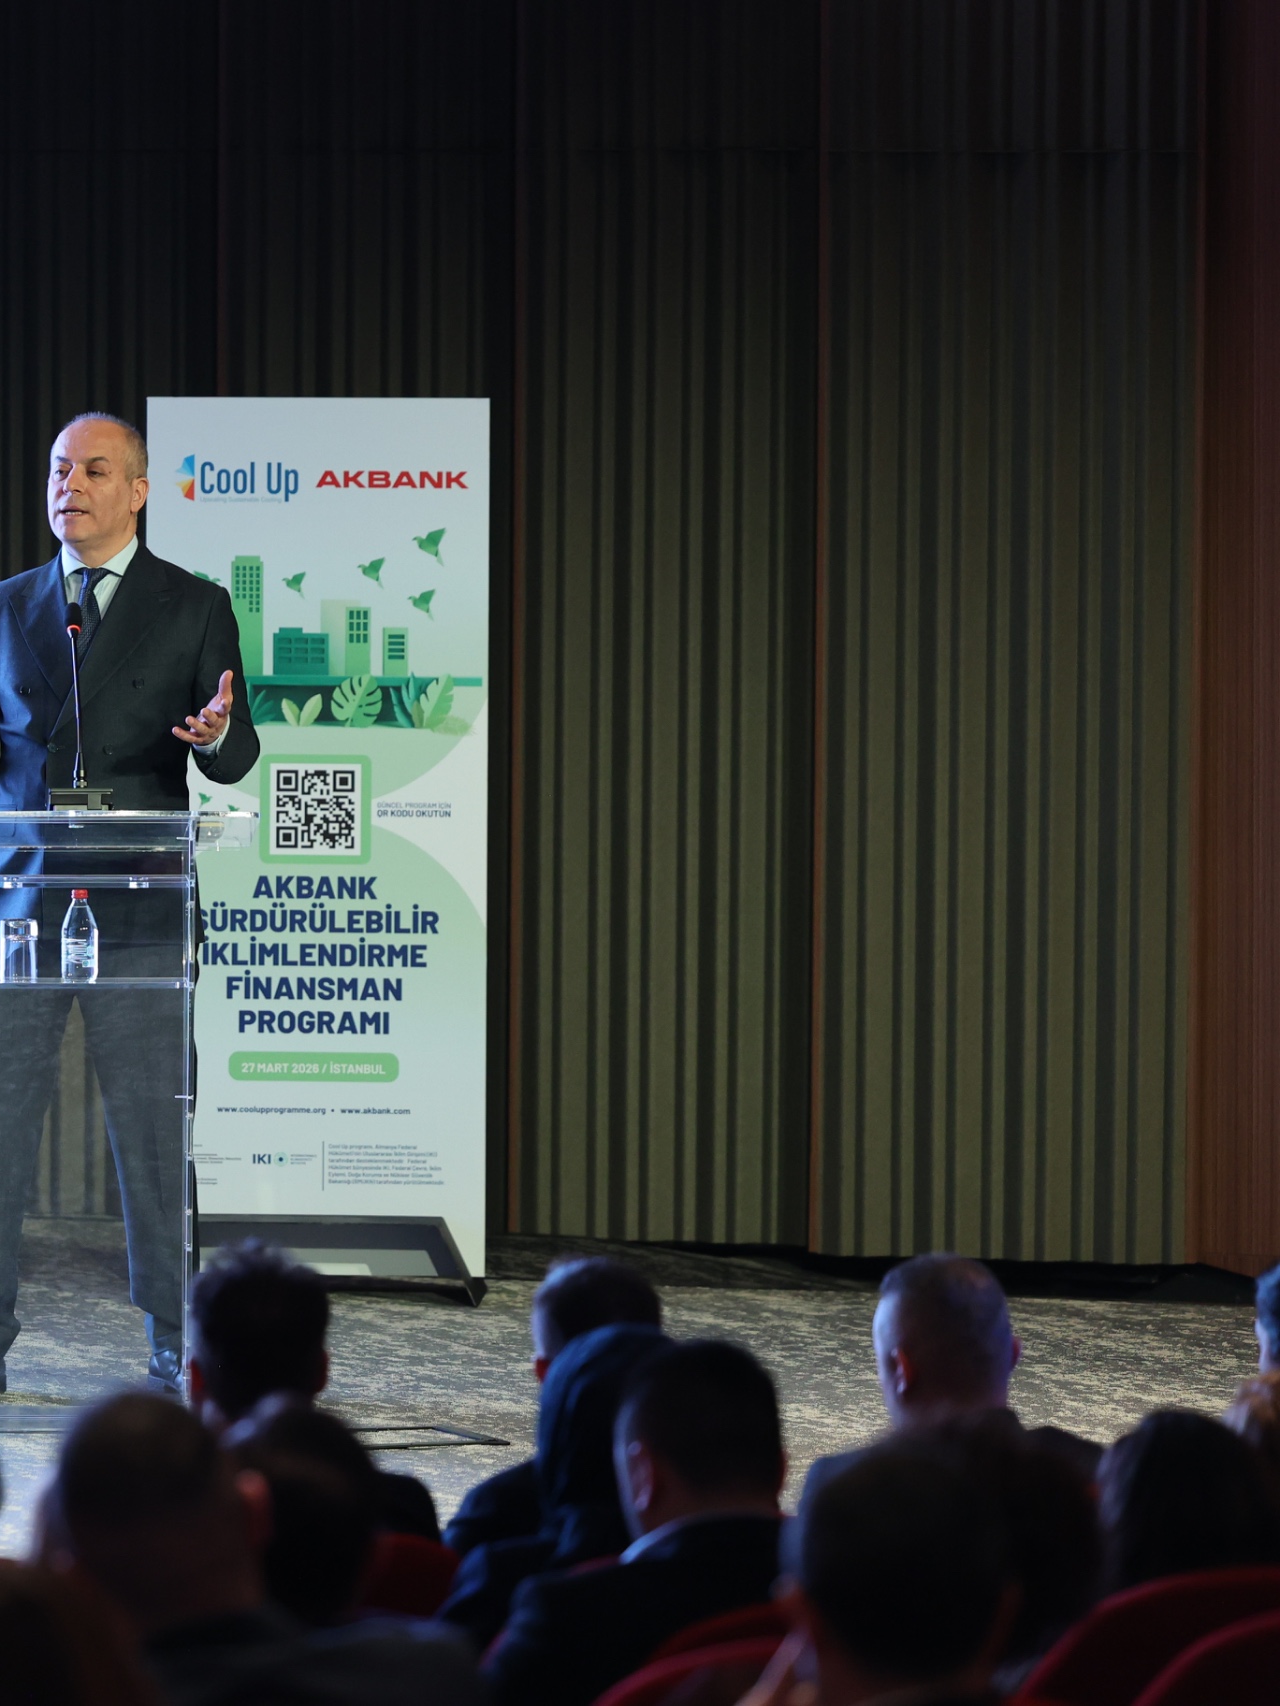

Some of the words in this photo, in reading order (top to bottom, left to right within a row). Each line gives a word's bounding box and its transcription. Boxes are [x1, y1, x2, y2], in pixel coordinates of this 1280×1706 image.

[200, 461, 255, 494] Cool
[267, 462, 299, 502] Up
[315, 470, 469, 489] AKBANK
[377, 801, 403, 809] GÜNCEL
[438, 801, 452, 810] İÇİN
[377, 809, 389, 818] QR
[390, 809, 414, 818] KODU
[415, 809, 451, 818] OKUTUN
[252, 875, 378, 900] AKBANK
[202, 936, 427, 968] İKLİMLENDİRME
[226, 969, 403, 1001] FİNANSMAN
[238, 1010, 390, 1035] PROGRAMI
[241, 1062, 255, 1074] 27
[257, 1062, 289, 1074] MART
[291, 1062, 320, 1074] 2026
[321, 1062, 327, 1074] /
[329, 1061, 386, 1075] İSTANBUL
[217, 1105, 326, 1115] www.coolupprogramme.org
[340, 1106, 411, 1115] www.akbank.com
[252, 1153, 271, 1164] IKI
